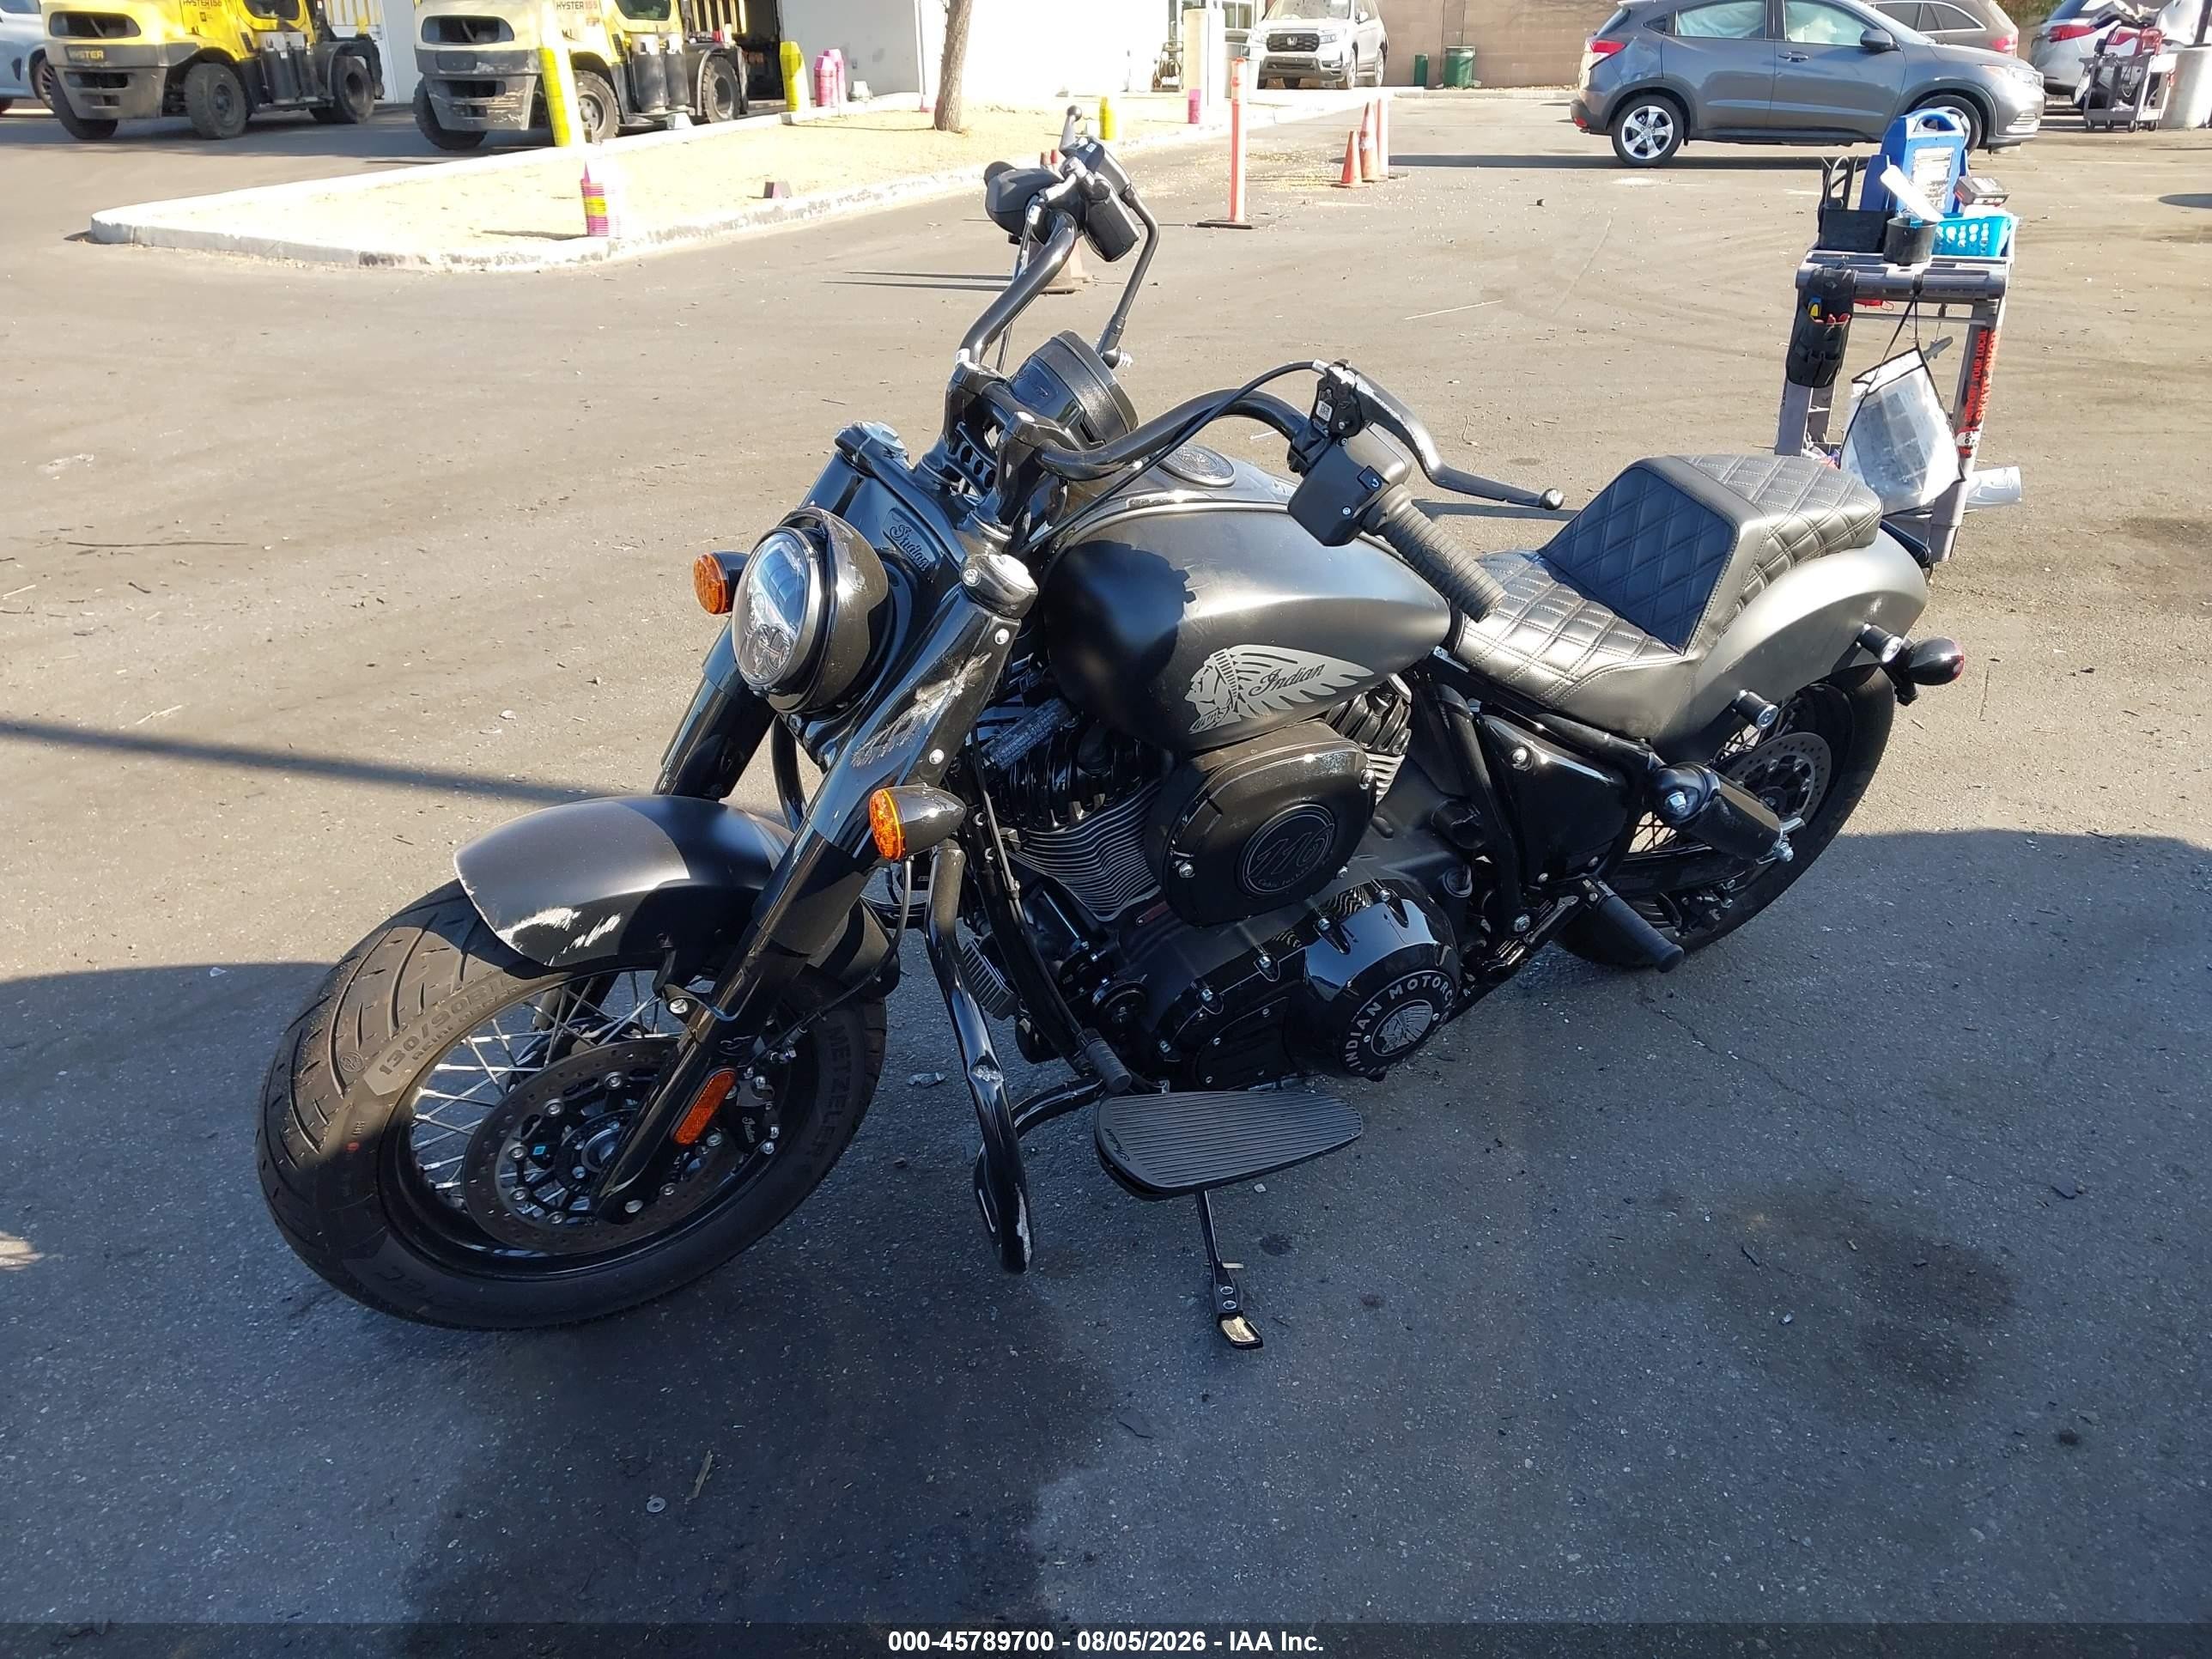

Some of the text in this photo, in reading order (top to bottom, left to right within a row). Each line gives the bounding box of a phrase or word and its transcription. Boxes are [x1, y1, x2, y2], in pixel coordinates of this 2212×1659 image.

[556, 1, 584, 10] HYSTER
[1976, 375, 1991, 421] SKATE
[889, 524, 930, 572] Indian
[1249, 664, 1326, 696] Indian
[1345, 1001, 1382, 1068] INDIAN
